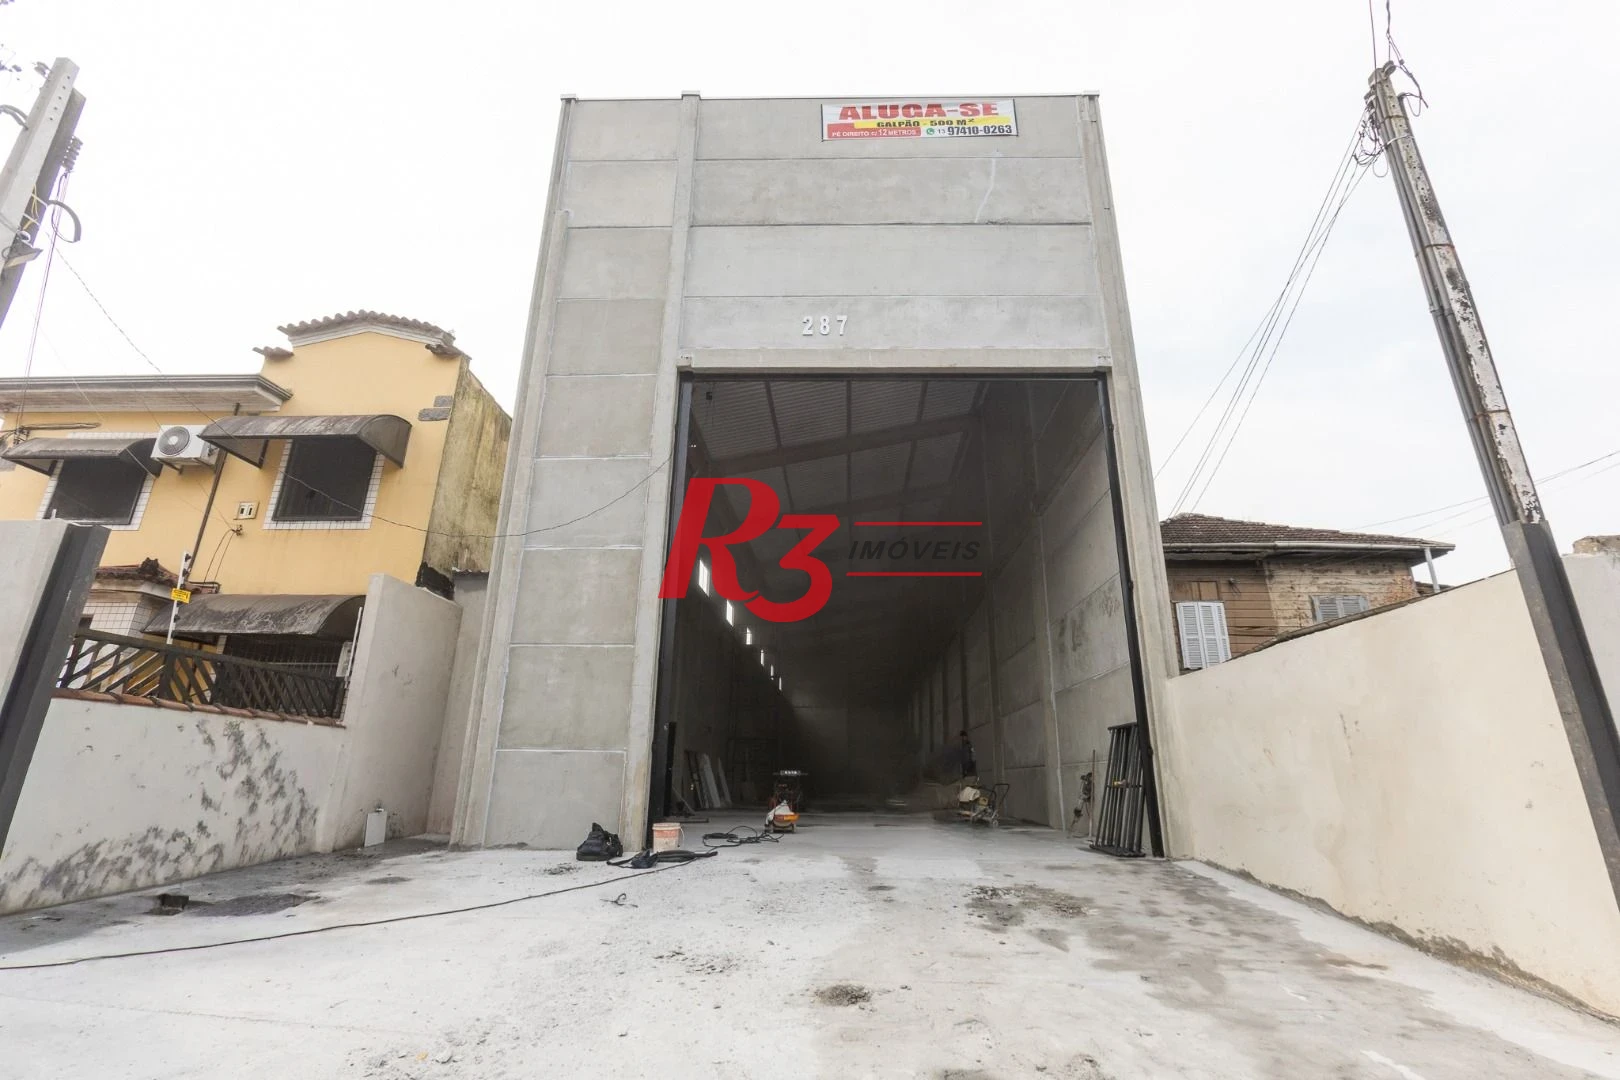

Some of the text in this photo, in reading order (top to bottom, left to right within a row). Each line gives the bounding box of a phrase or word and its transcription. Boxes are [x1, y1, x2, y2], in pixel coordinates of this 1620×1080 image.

[839, 103, 999, 120] ALUGA-SE
[877, 120, 920, 128] GALPÃO
[879, 128, 888, 136] 12
[947, 125, 1012, 136] 97410-0263
[802, 315, 848, 336] 287
